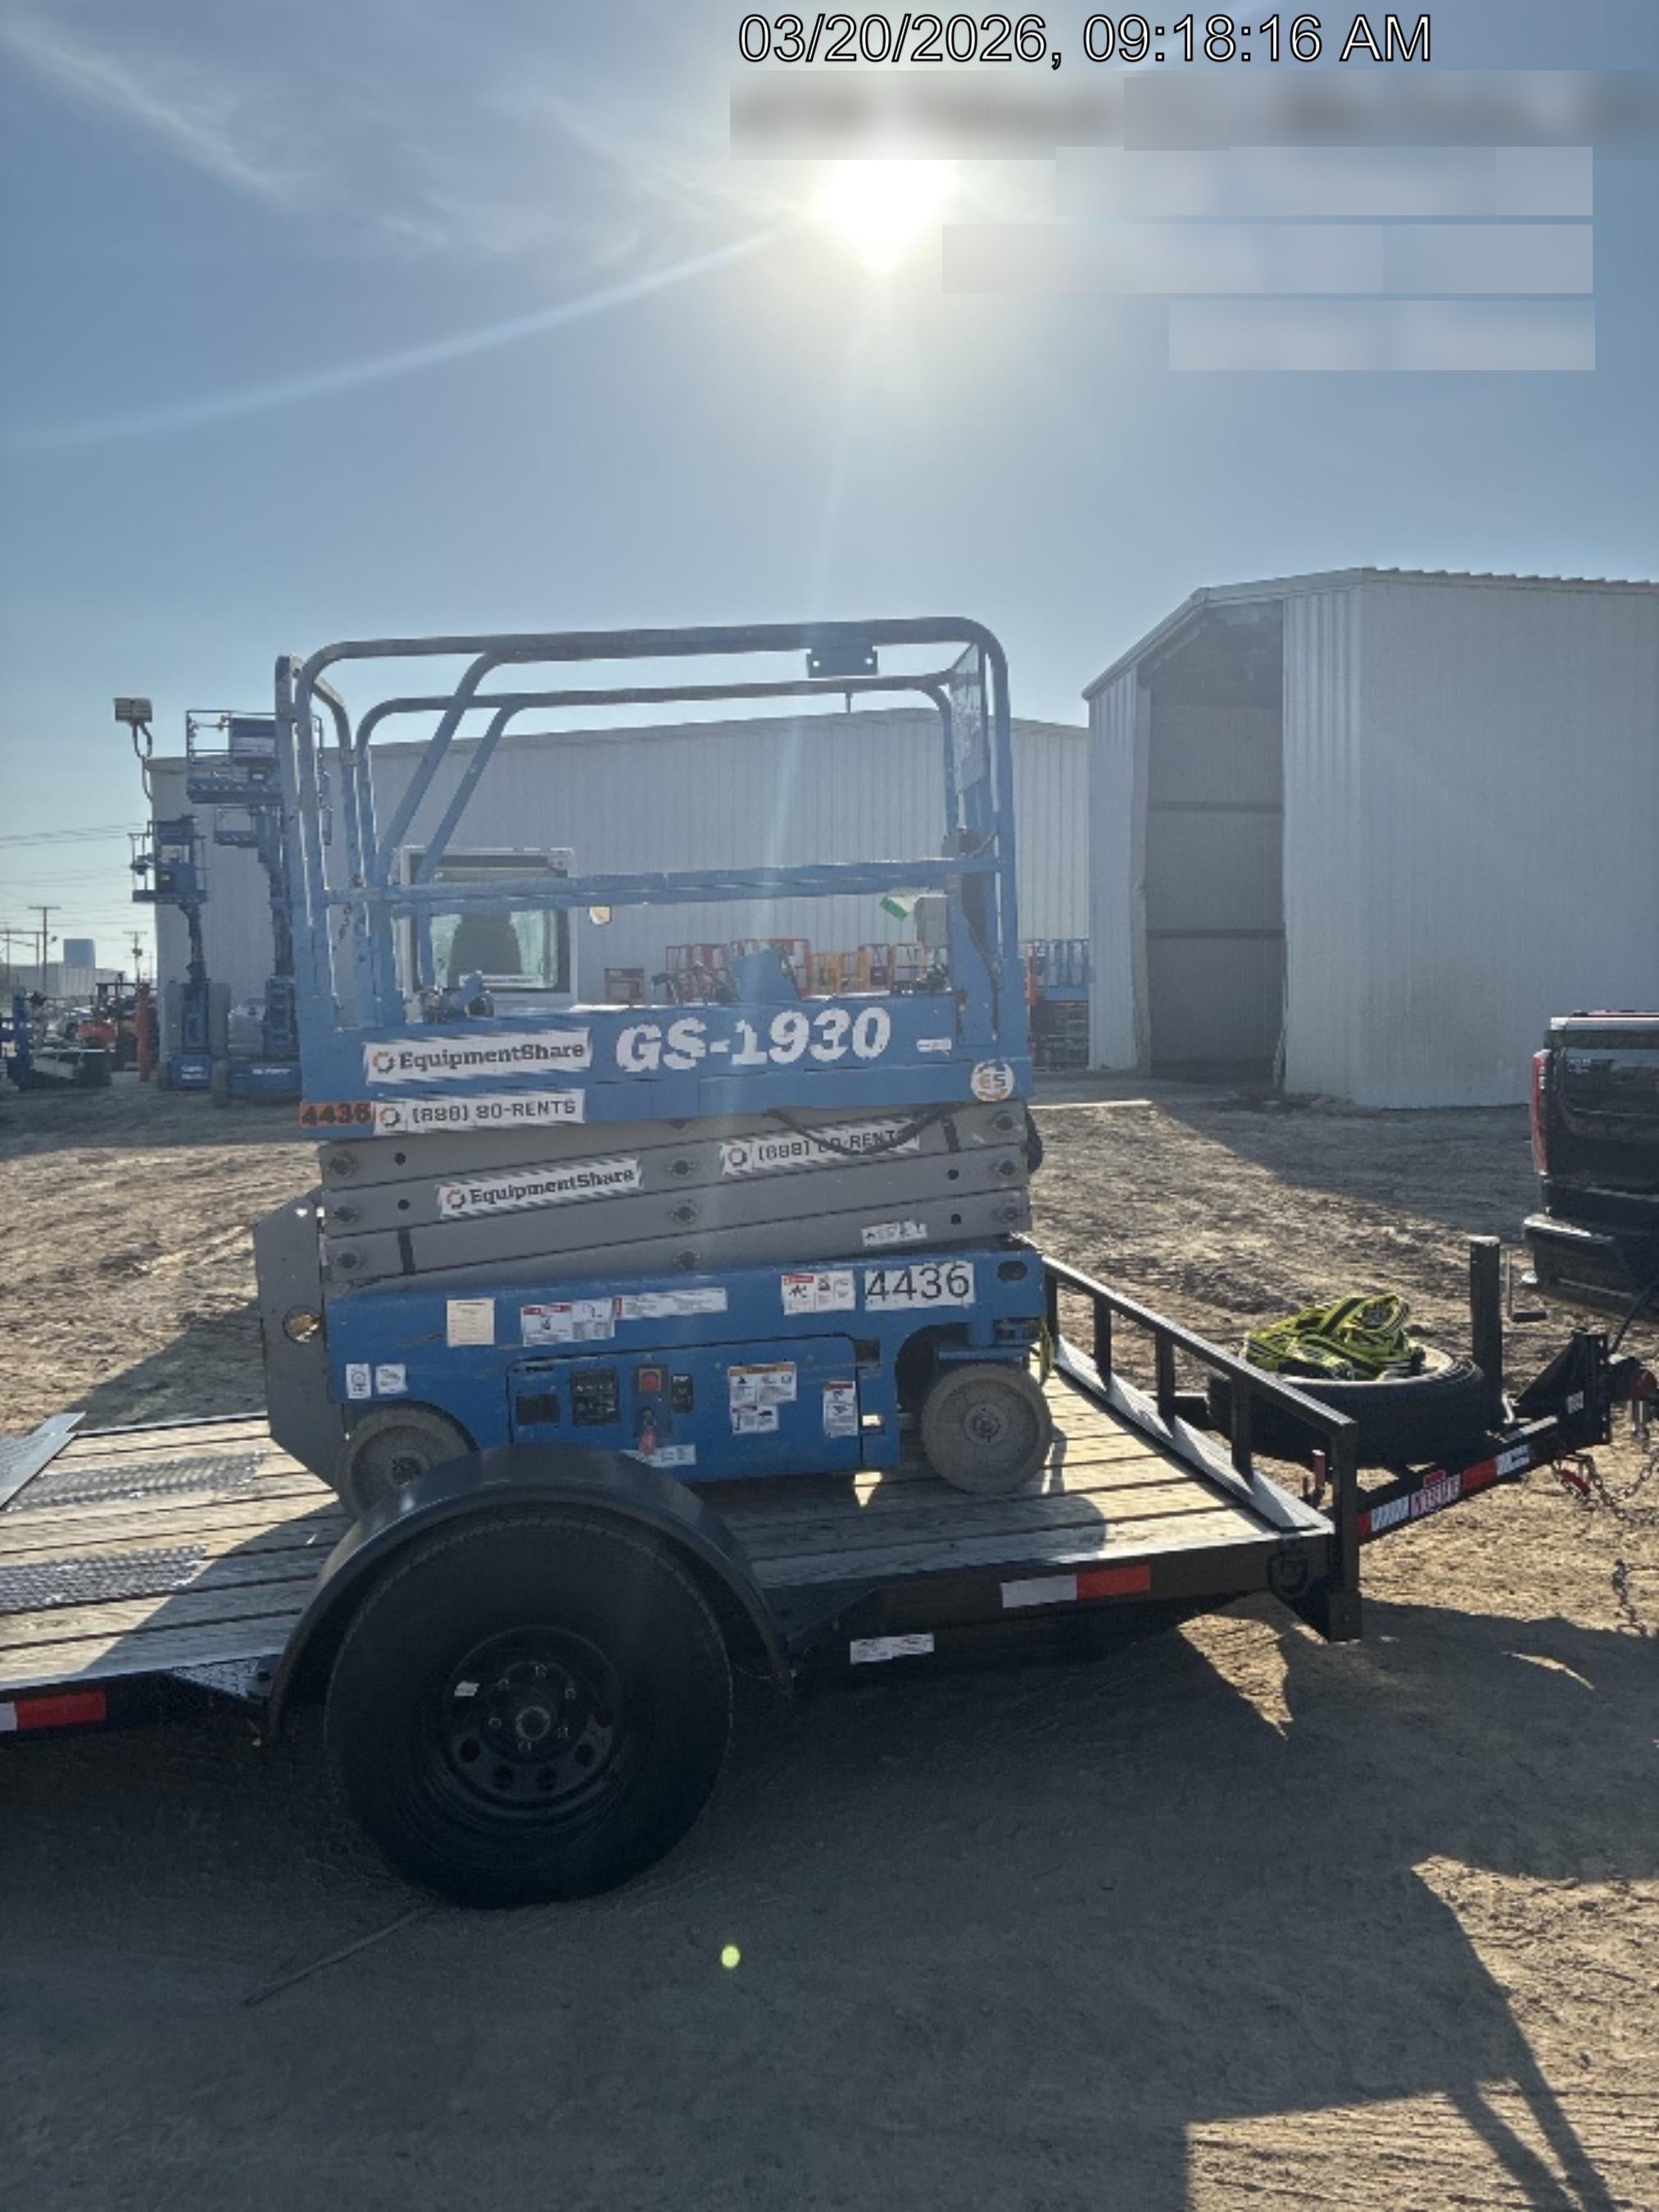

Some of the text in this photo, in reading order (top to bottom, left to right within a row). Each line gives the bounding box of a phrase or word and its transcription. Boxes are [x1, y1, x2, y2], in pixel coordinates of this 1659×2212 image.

[616, 1007, 891, 1072] GS-1930
[399, 1042, 586, 1072] EquipmentShare
[301, 1102, 371, 1126] 4436
[475, 1100, 577, 1120] 80-RENTS
[469, 1169, 635, 1204] EquipmentShare
[865, 1264, 971, 1301] 4436
